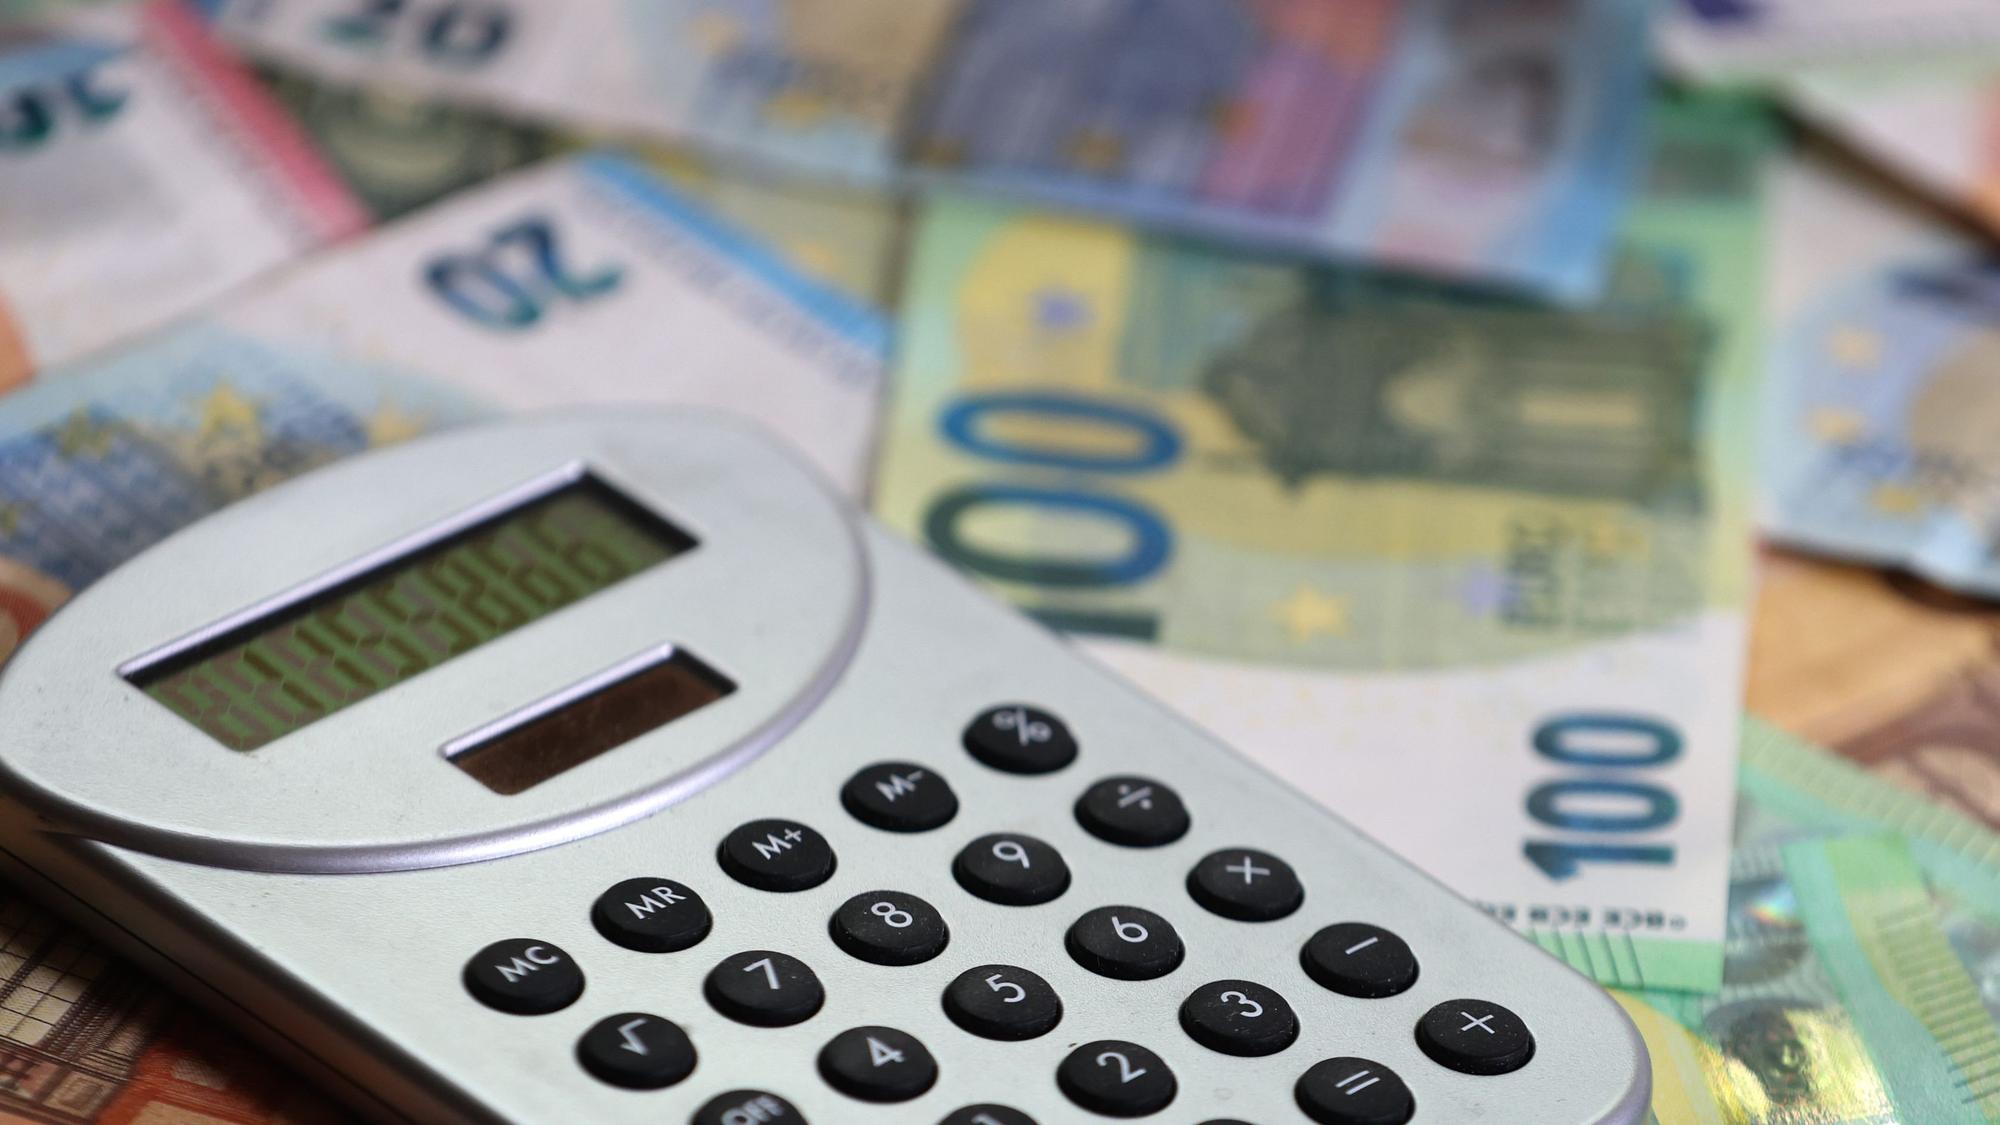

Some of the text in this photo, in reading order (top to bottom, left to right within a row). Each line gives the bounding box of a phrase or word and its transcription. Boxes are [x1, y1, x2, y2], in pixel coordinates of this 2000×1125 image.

[424, 216, 625, 330] 20
[993, 708, 1051, 745] %
[1523, 709, 1685, 882] 100
[752, 828, 803, 860] M+
[992, 841, 1030, 869] 9
[624, 886, 687, 920] MR
[870, 901, 914, 928] 8
[1111, 916, 1149, 943] 6
[495, 946, 559, 982] MC
[743, 958, 780, 990] 7
[984, 973, 1026, 1003] 5
[1220, 990, 1263, 1018] 3
[1460, 1011, 1495, 1035] +
[867, 1037, 903, 1067] 4
[1096, 1051, 1147, 1083] 2
